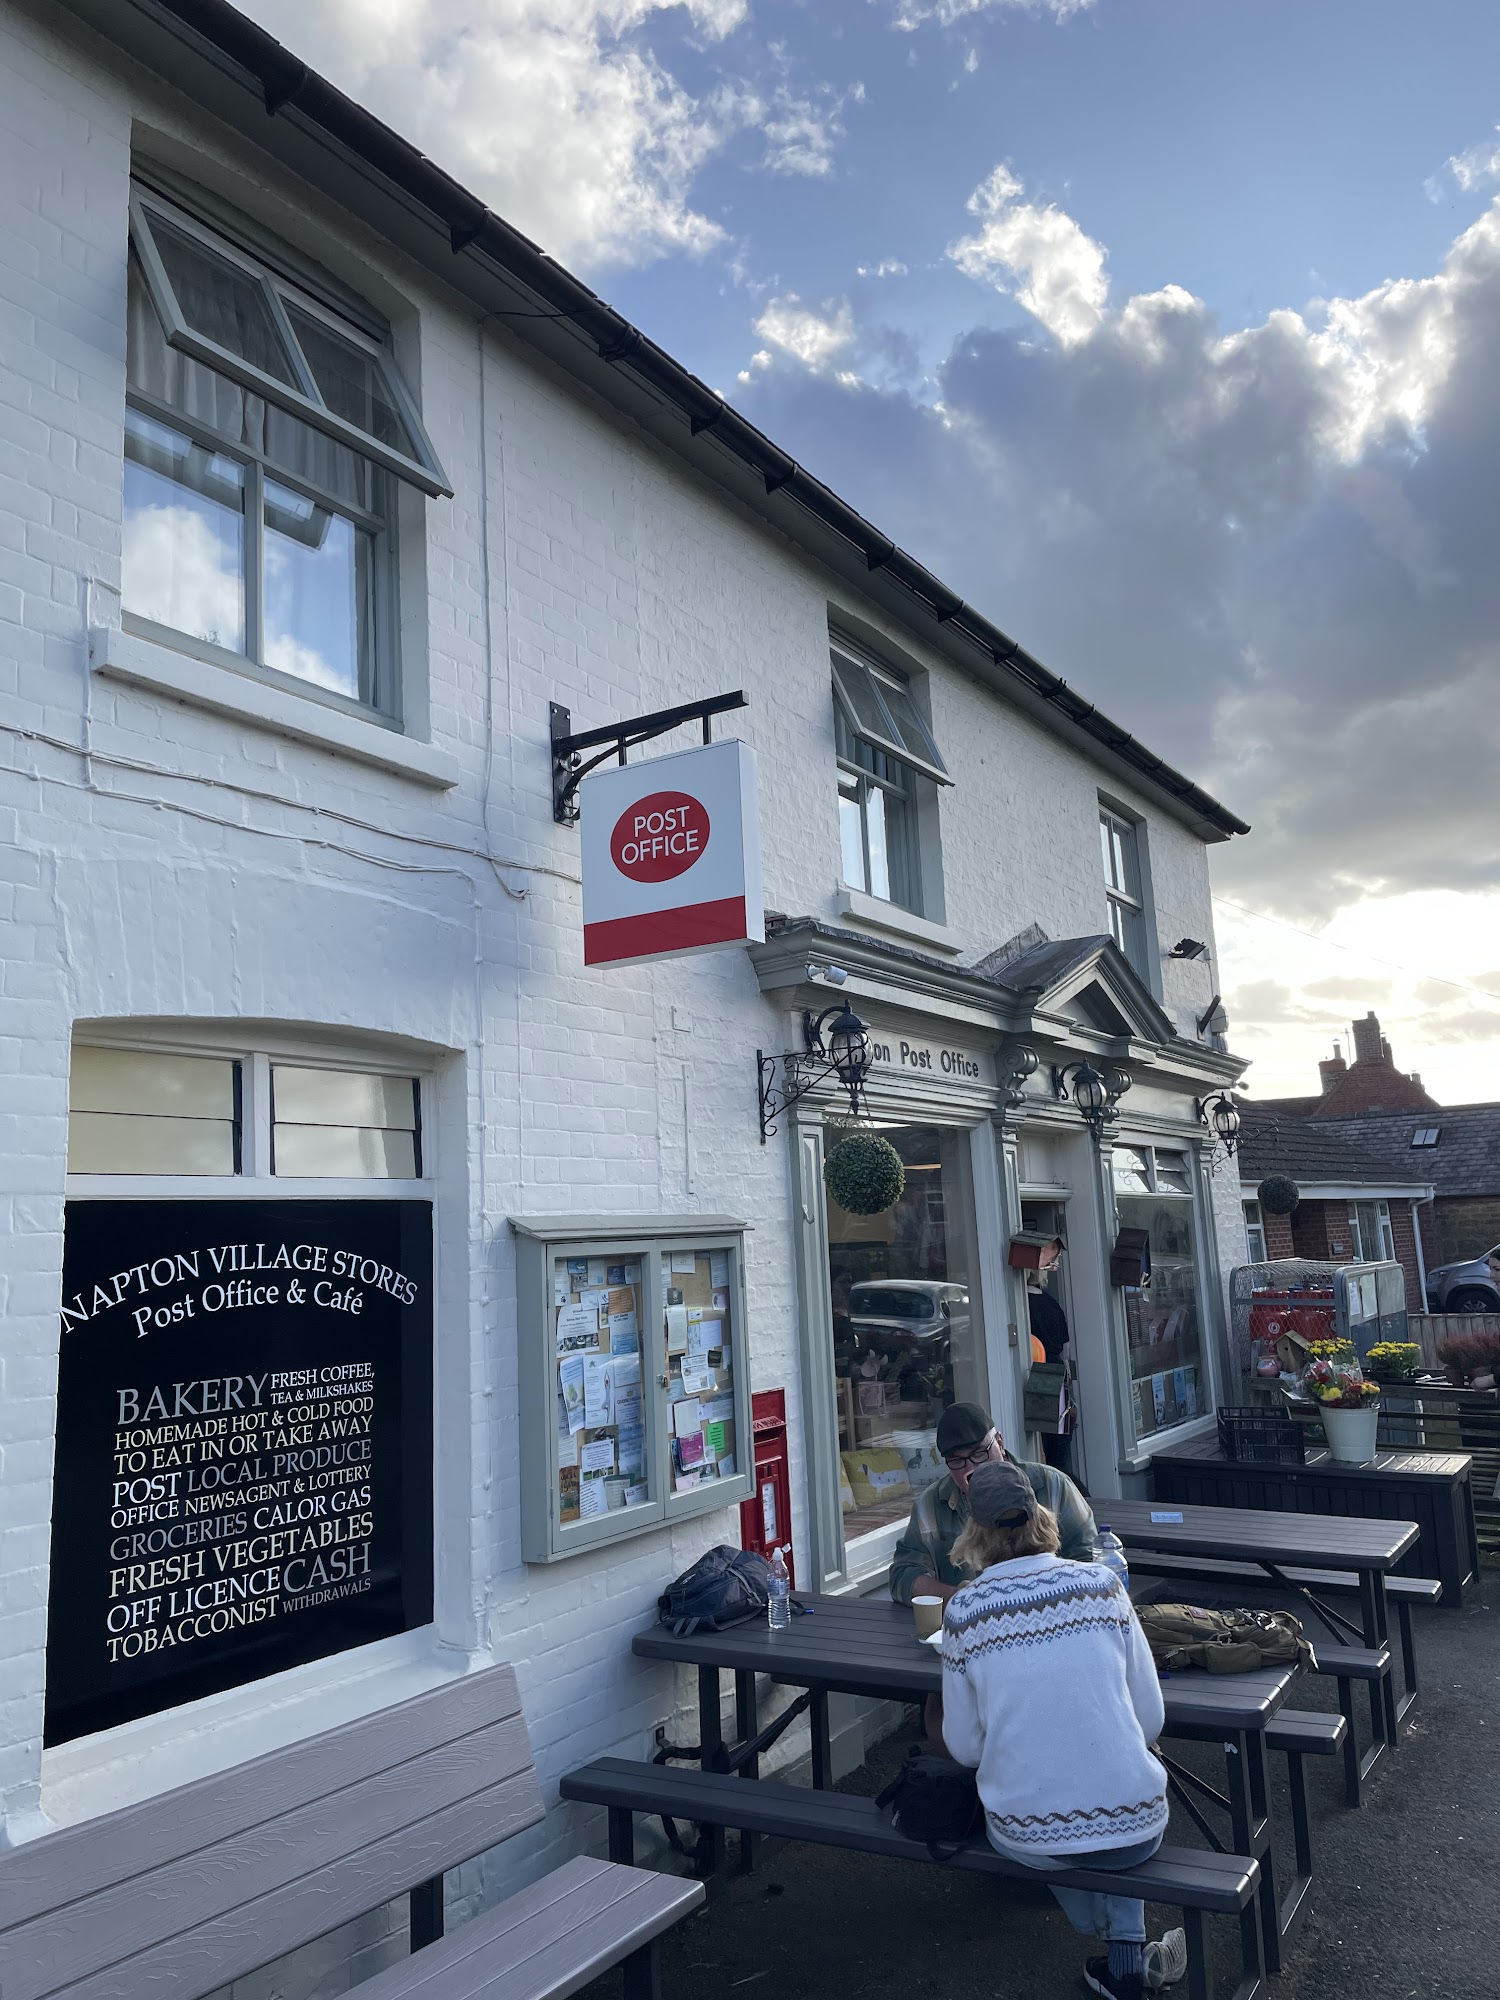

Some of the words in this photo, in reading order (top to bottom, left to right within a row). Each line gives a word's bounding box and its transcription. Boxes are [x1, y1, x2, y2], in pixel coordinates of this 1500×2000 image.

[621, 829, 699, 865] OFFICE
[634, 805, 690, 838] POST
[873, 1043, 890, 1062] on
[900, 1041, 933, 1070] Post
[940, 1049, 979, 1078] Office
[59, 1251, 199, 1333] NAPTON
[207, 1244, 328, 1273] VILLAGE
[332, 1250, 418, 1305] STORES
[132, 1294, 195, 1338] Post
[202, 1279, 279, 1312] Office
[287, 1278, 306, 1304] &
[313, 1281, 363, 1315] Café
[117, 1373, 268, 1425] BAKERY
[271, 1369, 318, 1389] FRESH
[321, 1362, 375, 1383] COFFEE,
[271, 1392, 293, 1405] TEA
[296, 1390, 304, 1401] &
[306, 1381, 373, 1400] MILKSHAKES
[114, 1451, 147, 1475] TO
[152, 1443, 195, 1468] EAT
[201, 1437, 224, 1460] IN
[229, 1432, 258, 1456] OR
[262, 1424, 314, 1450] TAKE
[317, 1415, 372, 1441] AWAY
[115, 1417, 227, 1450] HOMEMADE
[231, 1412, 268, 1432] HOT
[271, 1410, 284, 1426] &
[287, 1401, 330, 1423] COLD
[333, 1397, 374, 1416] FOOD
[112, 1472, 182, 1508] POST
[185, 1480, 290, 1516] NEWSAGENT
[293, 1479, 305, 1493] &
[309, 1464, 372, 1491] LOTTERY
[187, 1458, 267, 1493] LOCAL
[272, 1439, 372, 1477] PRODUCE
[110, 1500, 180, 1529] OFFICE
[253, 1495, 327, 1530] CALOR
[330, 1485, 372, 1512] GAS
[108, 1550, 205, 1598] FRESH
[213, 1511, 374, 1572] VEGETABLES
[110, 1511, 247, 1561] GROCERIES
[283, 1541, 372, 1593] CASH
[106, 1596, 162, 1633] OFF
[168, 1565, 282, 1618] LICENCE
[282, 1578, 371, 1614] WITHDRAWALS
[106, 1595, 280, 1663] TOBACCONIST
